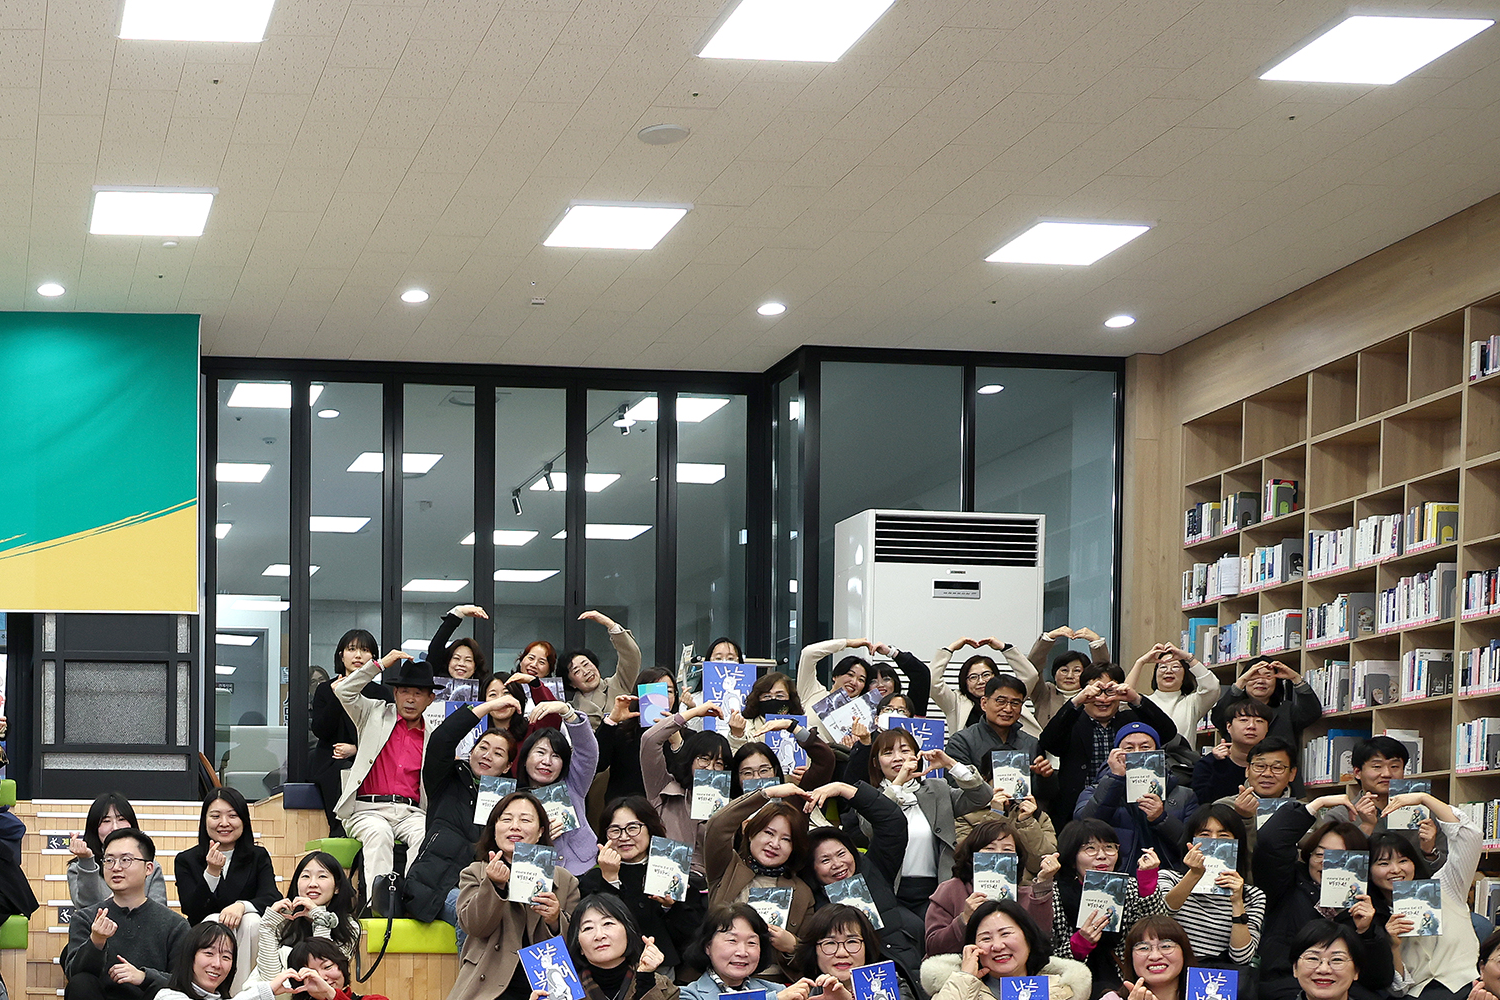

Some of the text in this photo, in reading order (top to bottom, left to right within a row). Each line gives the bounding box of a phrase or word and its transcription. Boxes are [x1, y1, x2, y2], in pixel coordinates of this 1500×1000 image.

[529, 943, 558, 960] 나는
[862, 966, 888, 982] 나는
[1199, 971, 1228, 987] 나는
[1011, 979, 1040, 993] 나는
